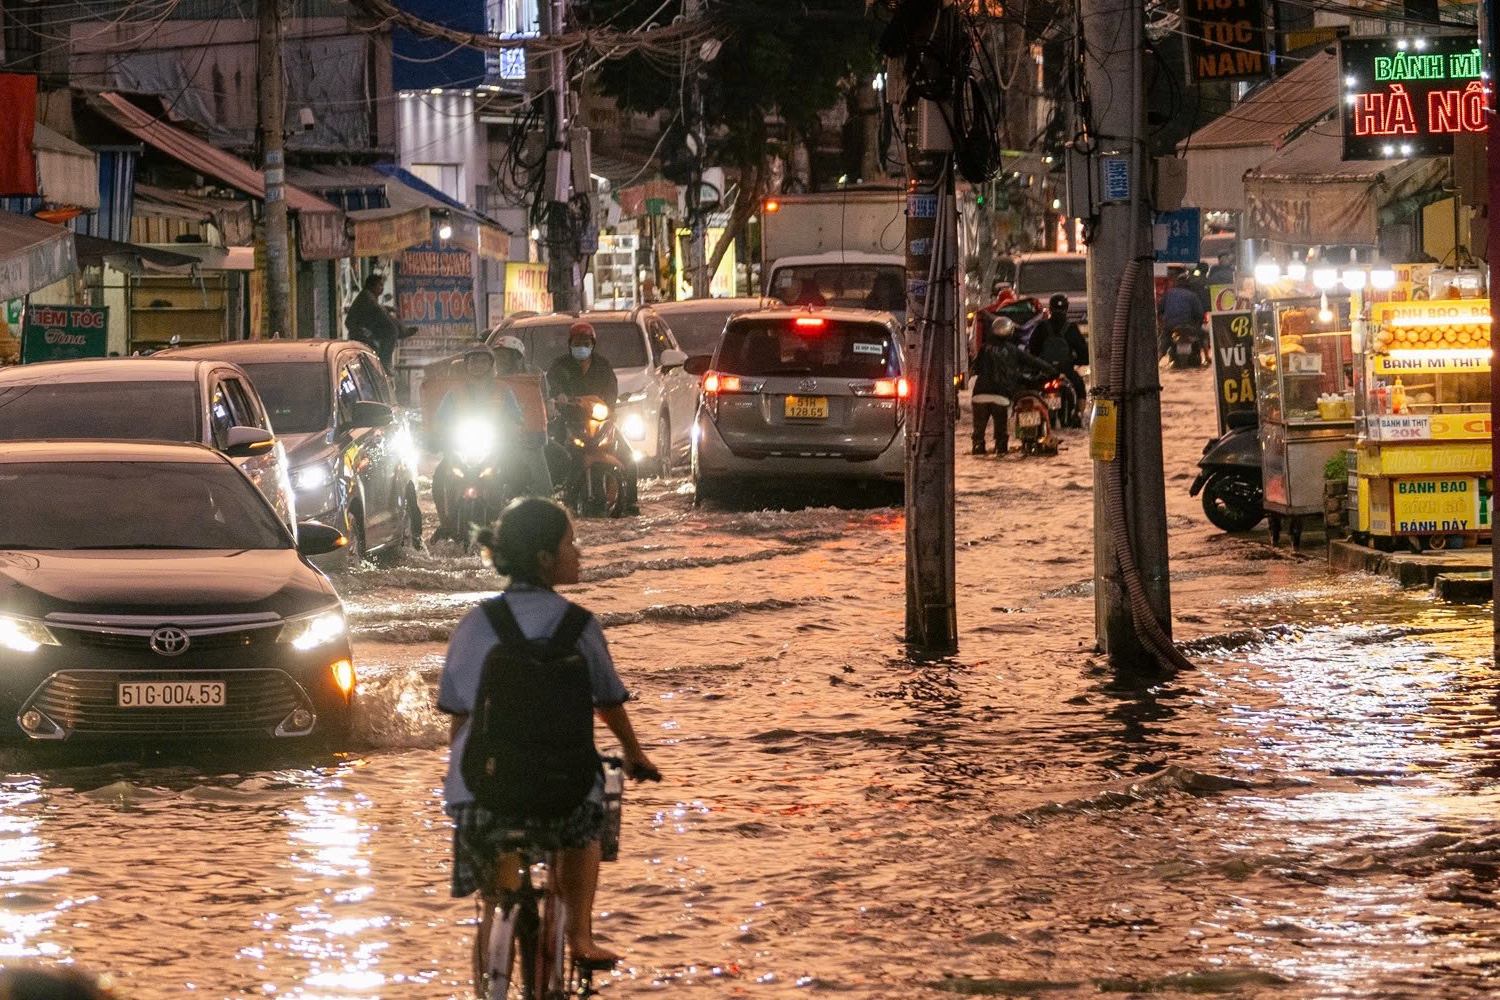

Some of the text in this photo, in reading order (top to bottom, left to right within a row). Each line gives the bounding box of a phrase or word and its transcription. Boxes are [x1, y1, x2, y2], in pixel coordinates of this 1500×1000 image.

[1199, 50, 1262, 77] NAM
[1374, 52, 1445, 81] BÁNH
[1354, 84, 1419, 136] HÀ
[70, 308, 104, 328] TÓC
[1440, 480, 1468, 493] BAO
[122, 684, 222, 705] 51G-004.53
